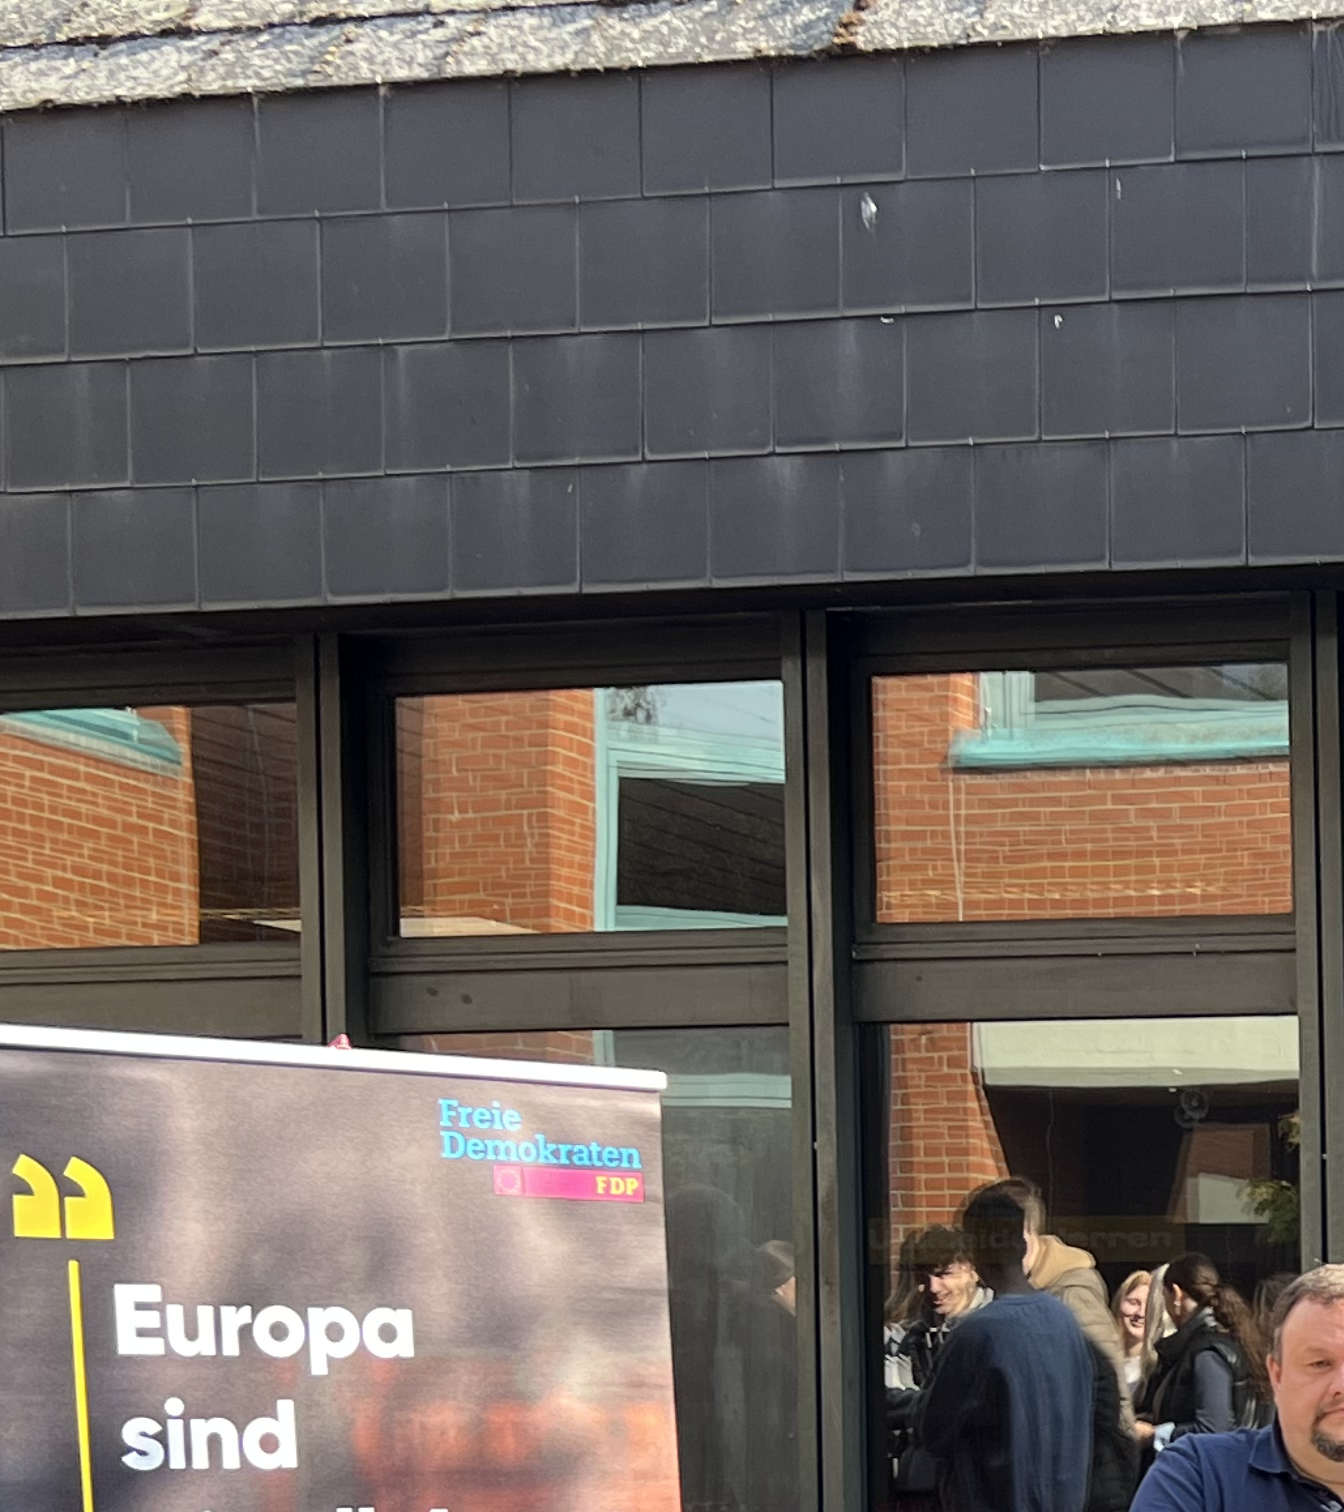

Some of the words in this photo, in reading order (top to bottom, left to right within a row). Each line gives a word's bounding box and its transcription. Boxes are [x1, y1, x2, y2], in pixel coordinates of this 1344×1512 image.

[438, 1098, 522, 1131] Freie
[440, 1130, 642, 1169] Demokraten
[595, 1176, 639, 1196] FDP
[113, 1284, 415, 1375] Europa
[120, 1397, 298, 1471] sind
